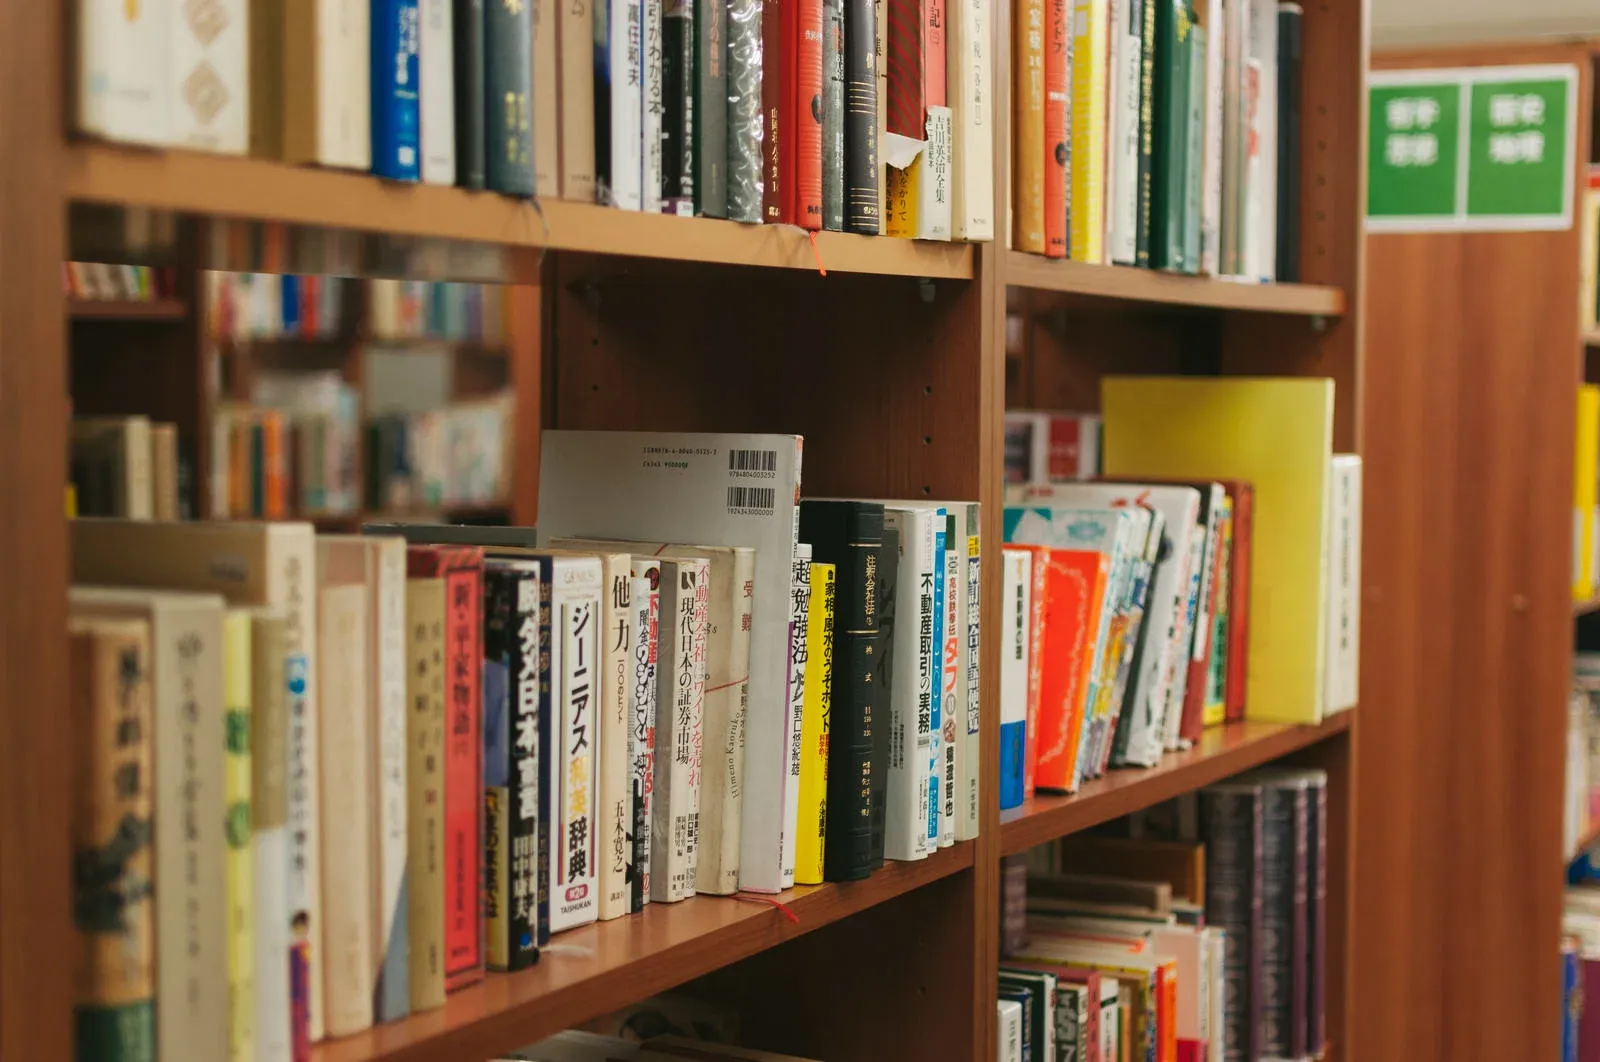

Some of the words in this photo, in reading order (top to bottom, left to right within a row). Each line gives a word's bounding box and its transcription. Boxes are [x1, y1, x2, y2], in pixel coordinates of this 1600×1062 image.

[647, 0, 662, 114] 引がわかる本
[935, 114, 945, 205] 吉川英治全集
[611, 574, 631, 655] 他力
[919, 573, 933, 734] 不動産取引の実務
[675, 597, 694, 766] 現代日本の証券市場
[567, 602, 590, 884] ジーニアス和英辞典
[791, 705, 803, 776] 野口悠紀雄
[612, 799, 626, 873] 五木寛之
[560, 899, 592, 915] TAISHUKAN
